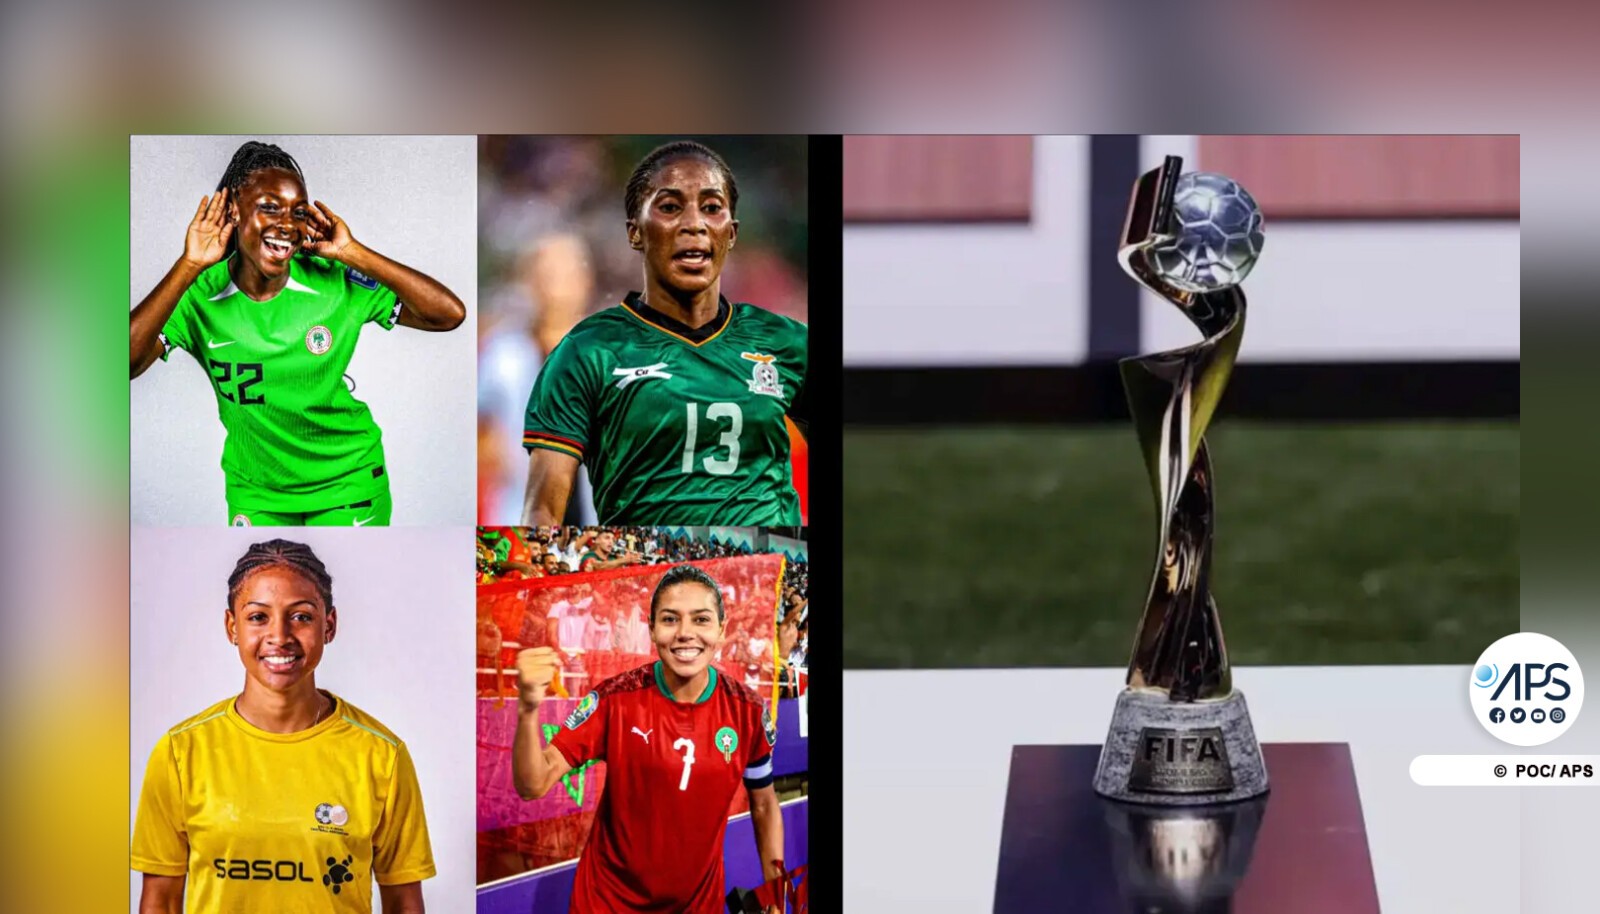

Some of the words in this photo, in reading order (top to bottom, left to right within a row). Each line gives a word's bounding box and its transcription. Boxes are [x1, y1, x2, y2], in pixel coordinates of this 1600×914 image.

[208, 358, 265, 405] 22
[681, 402, 743, 475] 13
[673, 737, 696, 791] 7
[1145, 736, 1221, 762] FIFA
